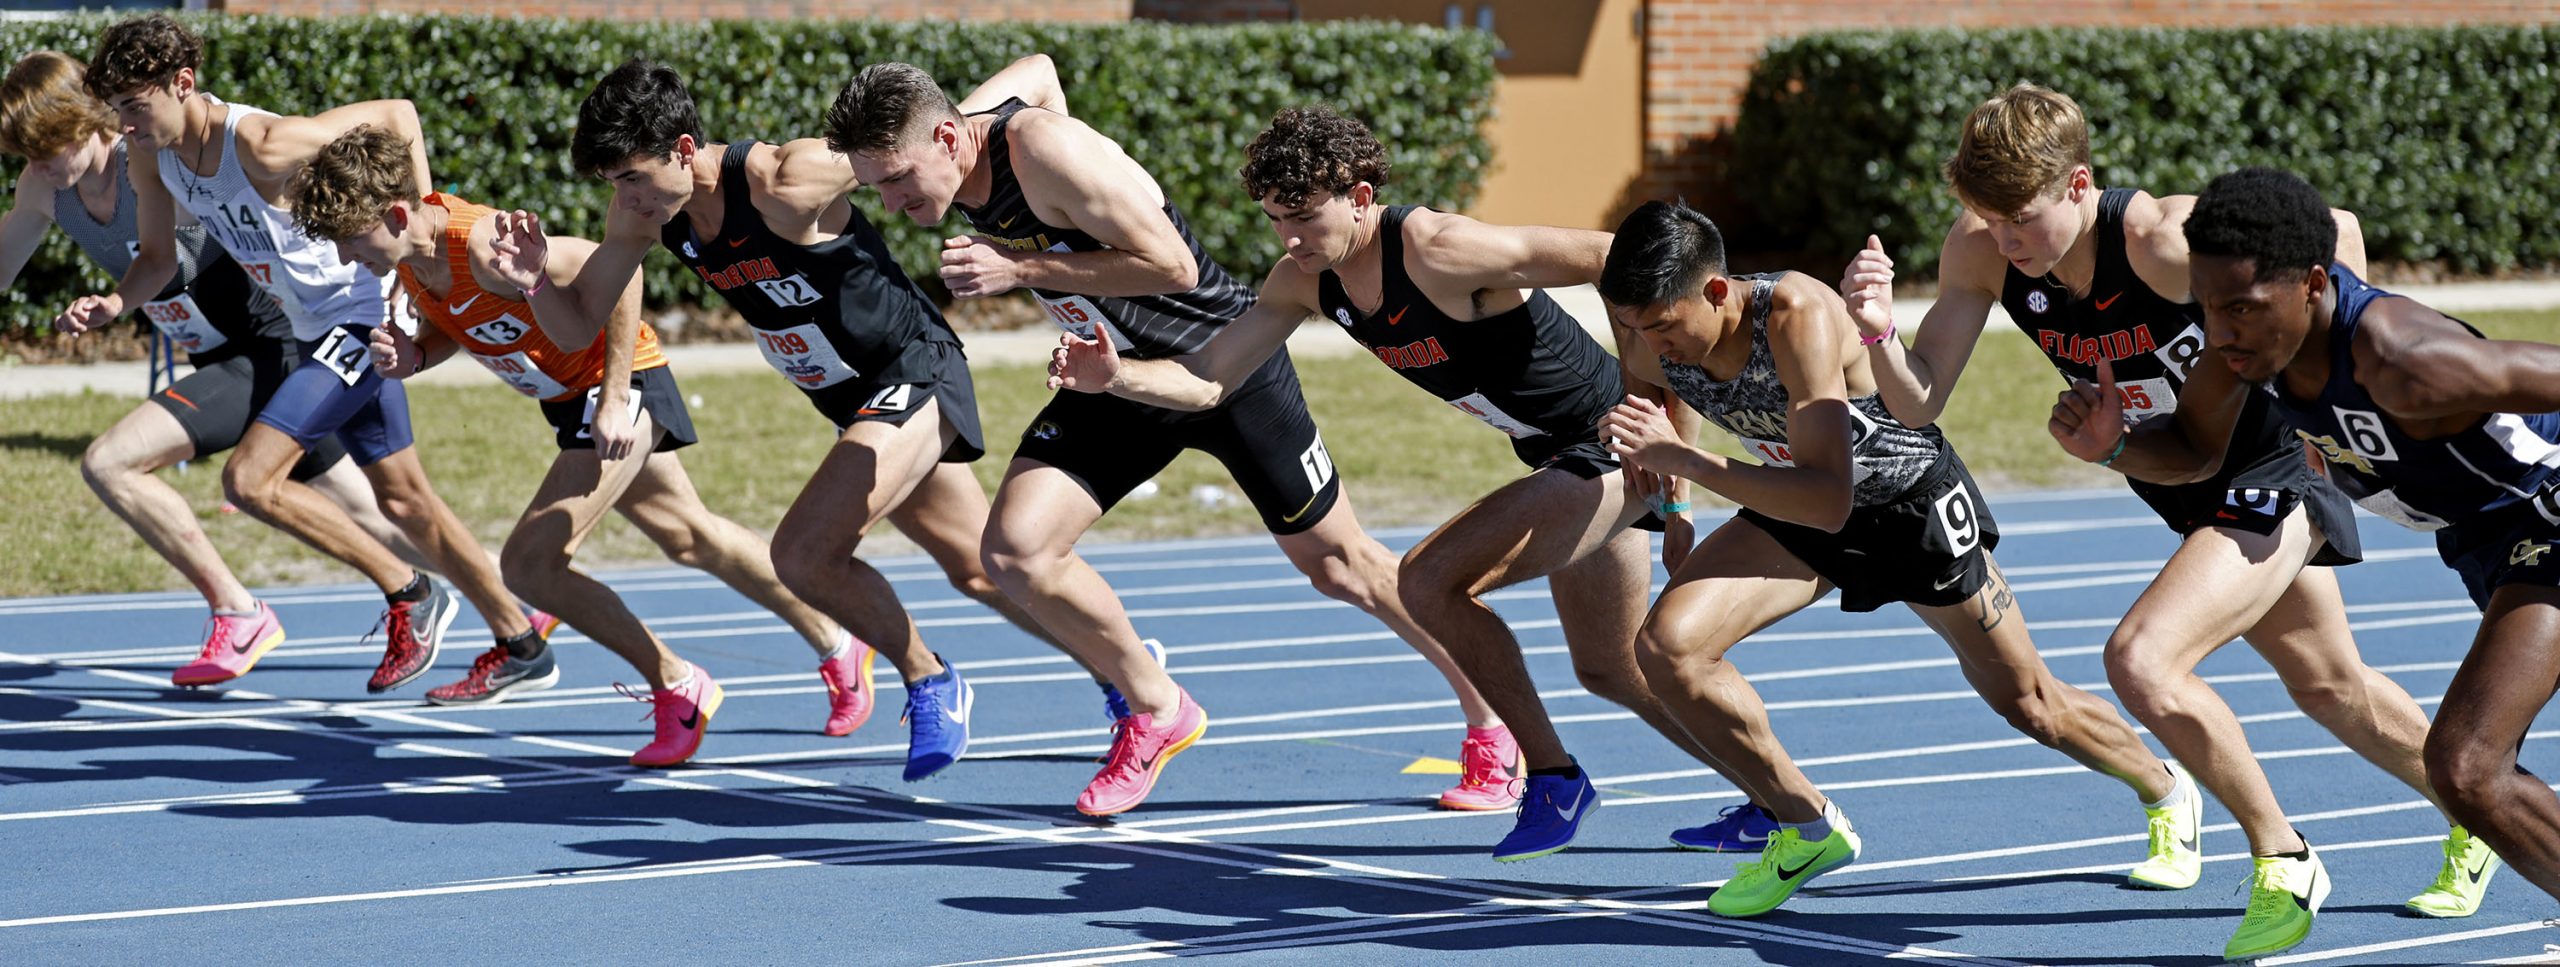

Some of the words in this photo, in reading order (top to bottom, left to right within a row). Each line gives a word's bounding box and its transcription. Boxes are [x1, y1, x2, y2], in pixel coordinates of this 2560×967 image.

[218, 203, 259, 230] 14
[764, 281, 814, 305] 12
[2028, 290, 2048, 314] SEC
[474, 320, 522, 345] 13
[758, 332, 810, 355] 789
[2038, 323, 2157, 367] FLORIDA
[323, 333, 366, 376] 14
[2167, 335, 2201, 376] 8
[2344, 413, 2386, 456] 6
[1946, 492, 1976, 547] 9
